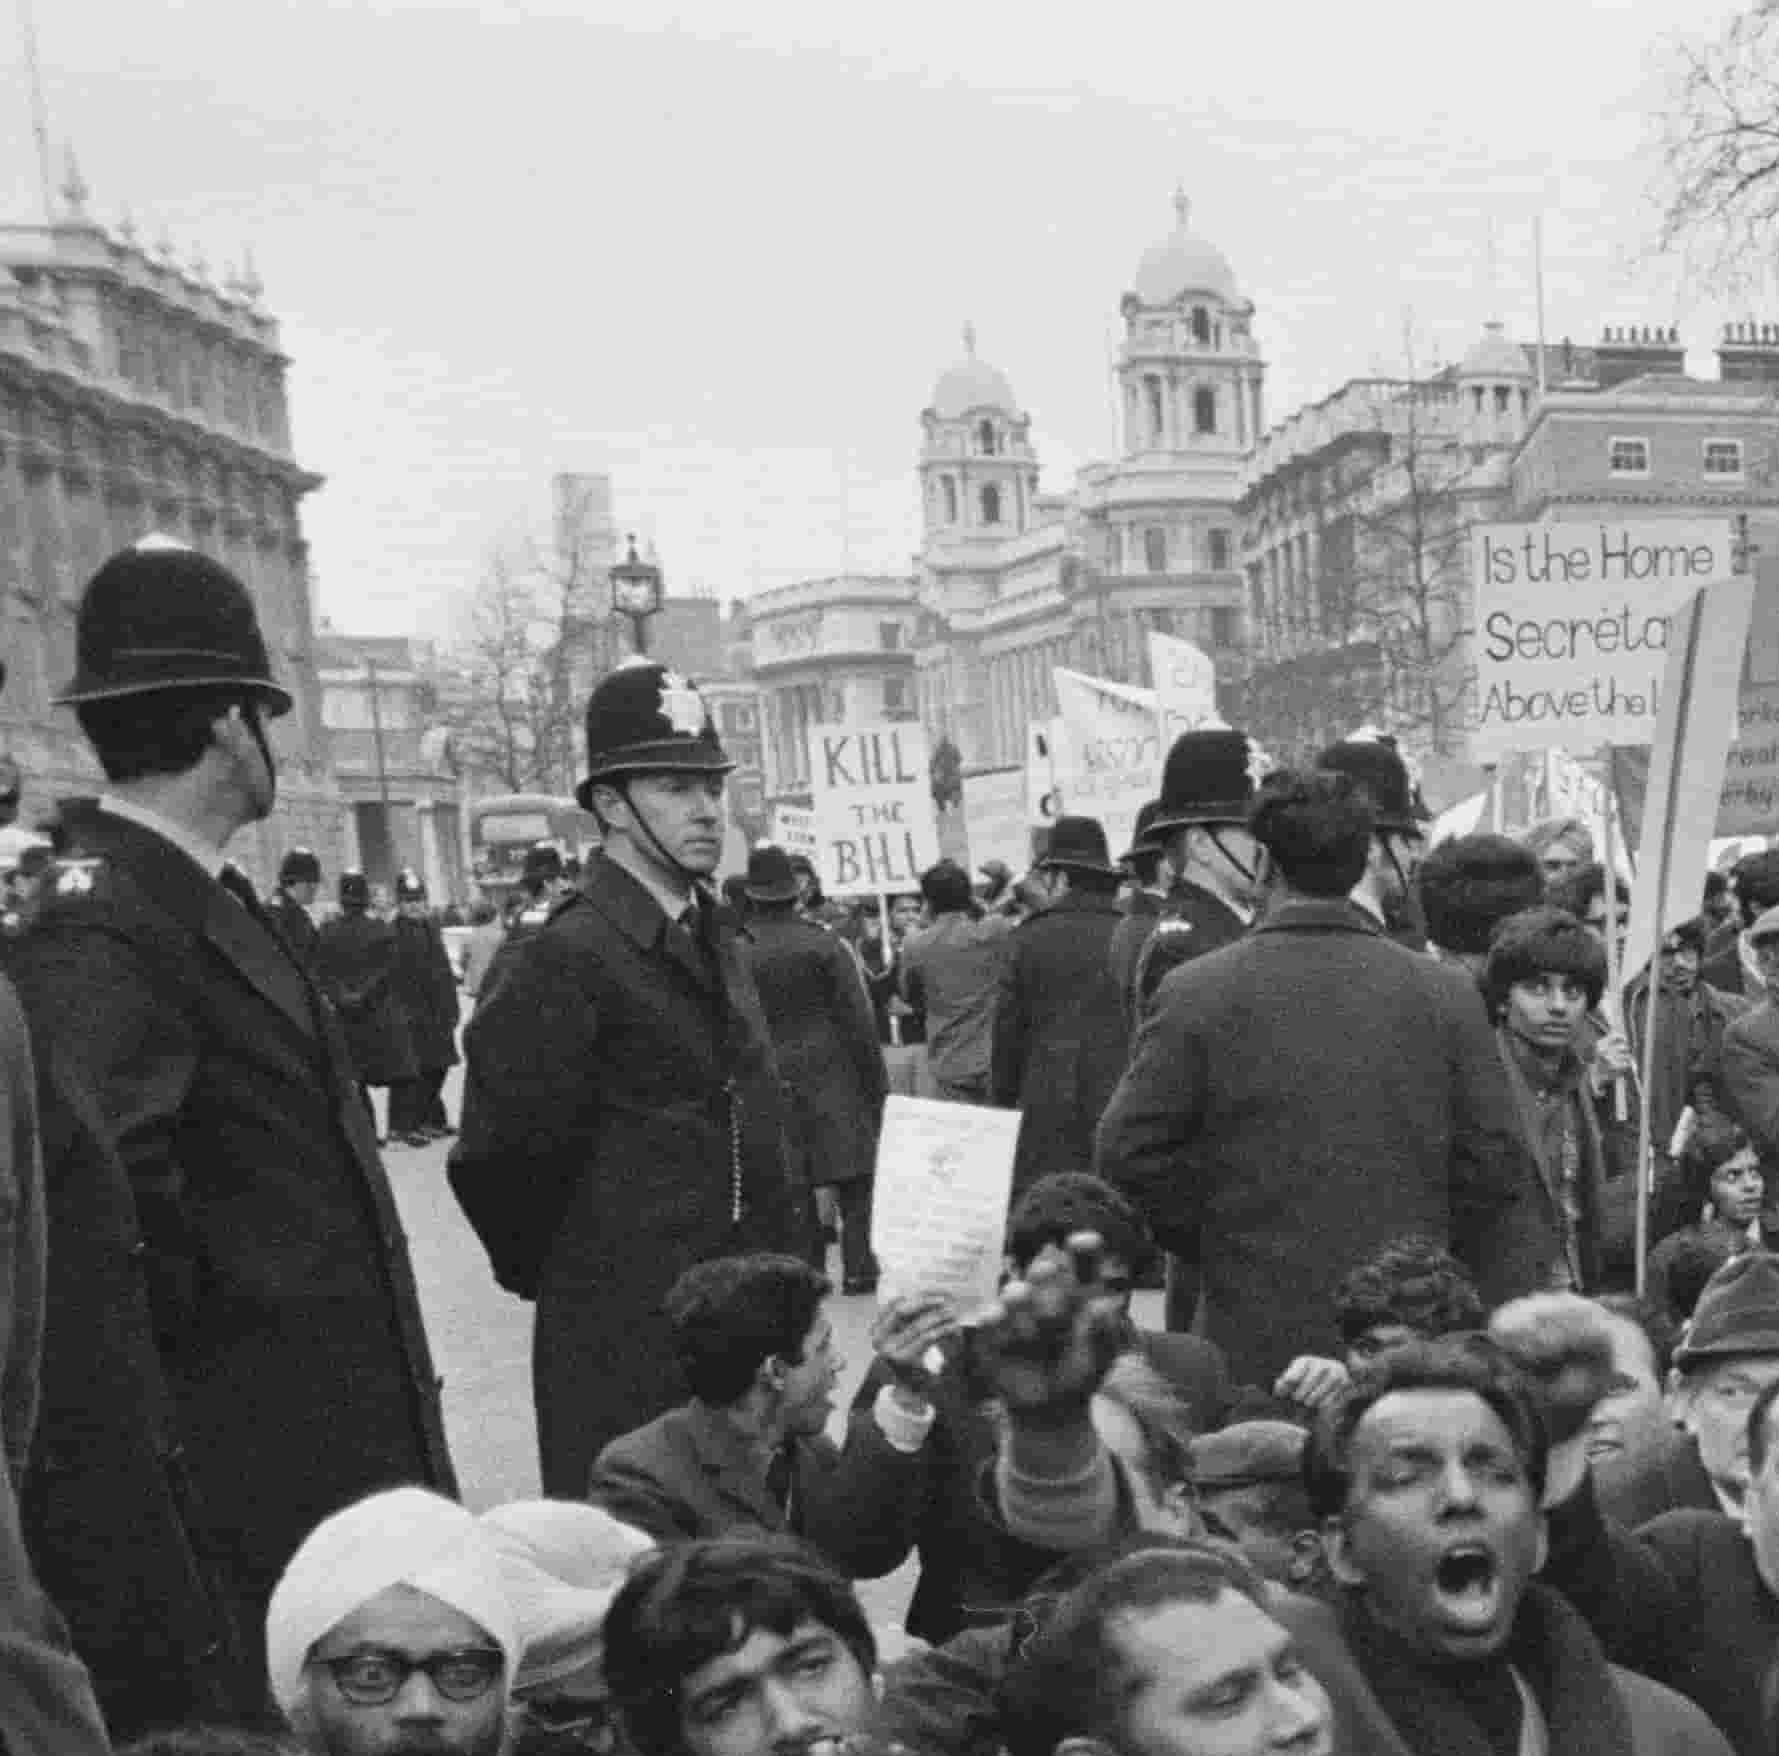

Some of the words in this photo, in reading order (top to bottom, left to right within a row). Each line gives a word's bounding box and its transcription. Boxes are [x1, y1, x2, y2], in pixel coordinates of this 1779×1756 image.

[1484, 535, 1516, 585] Is
[1520, 531, 1590, 582] the
[1600, 527, 1713, 580] Home
[1486, 604, 1668, 662] Secreta
[1480, 678, 1590, 722] Above
[823, 731, 916, 788] KILL
[848, 800, 905, 825] THE
[831, 831, 920, 885] BILL
